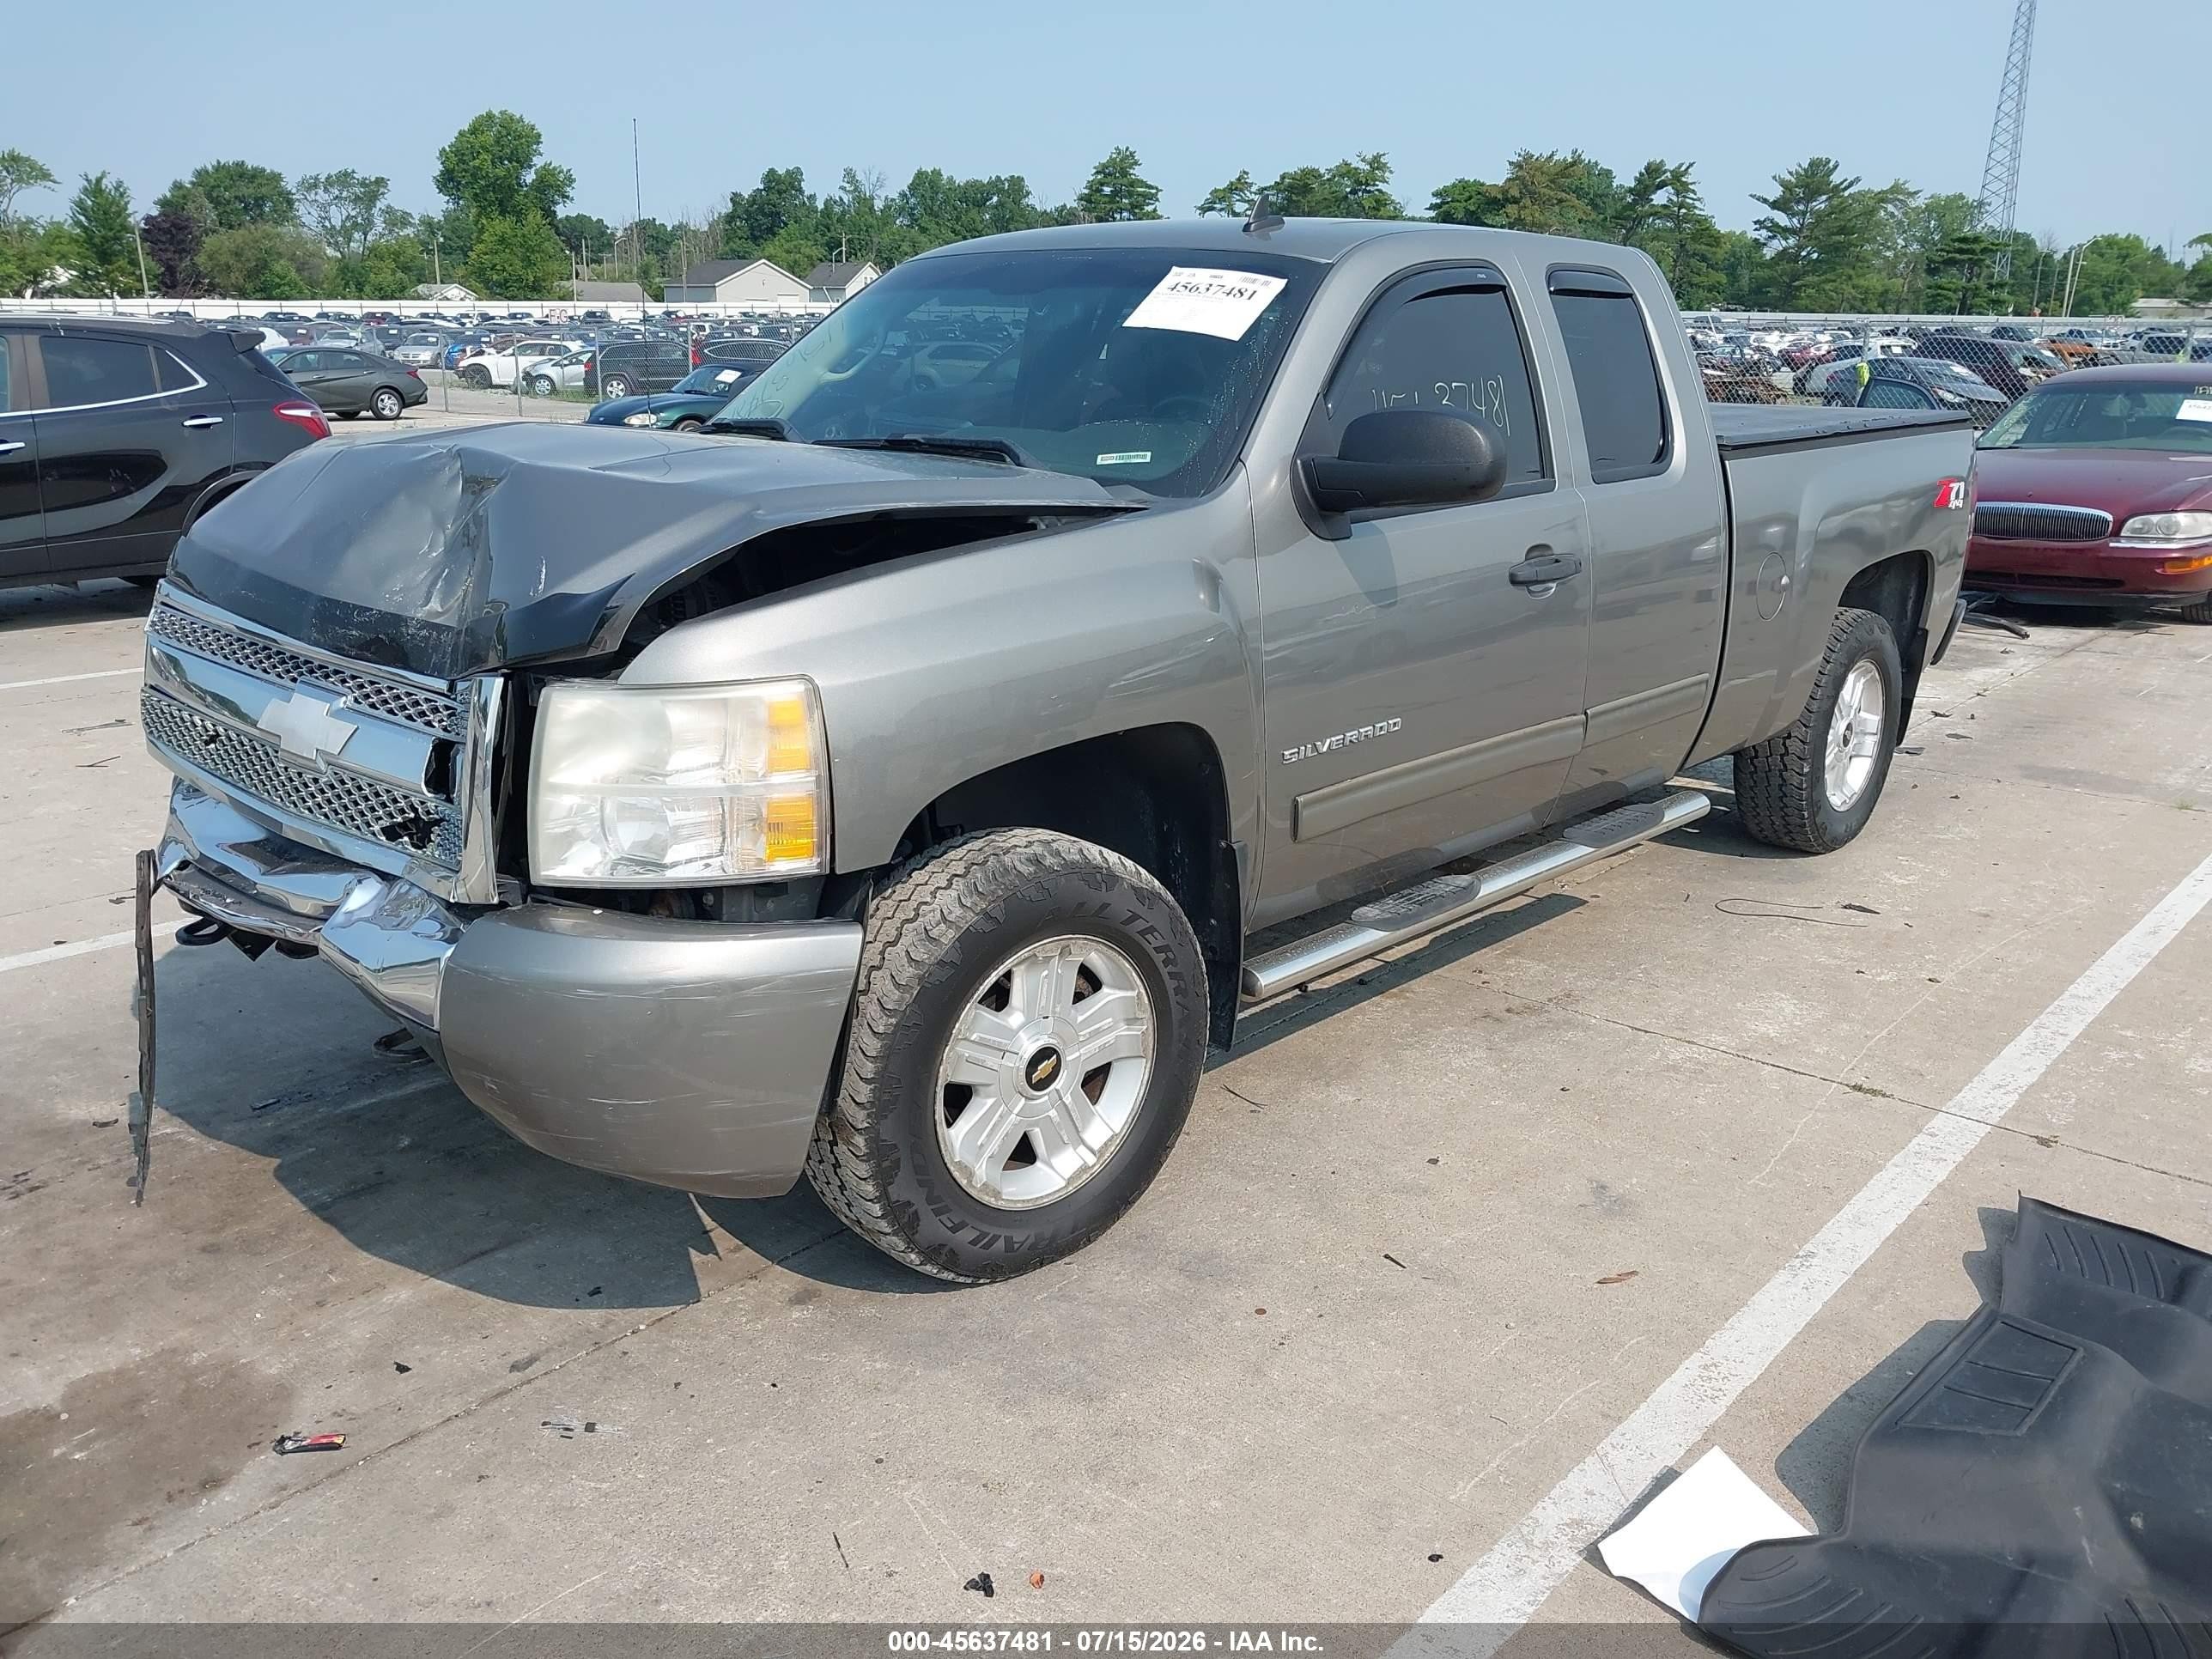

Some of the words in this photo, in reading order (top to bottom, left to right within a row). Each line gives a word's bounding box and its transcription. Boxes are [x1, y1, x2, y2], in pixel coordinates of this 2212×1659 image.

[1168, 282, 1257, 301] 45637481
[1934, 477, 1965, 508] Z71
[1282, 717, 1402, 764] SILVERADO
